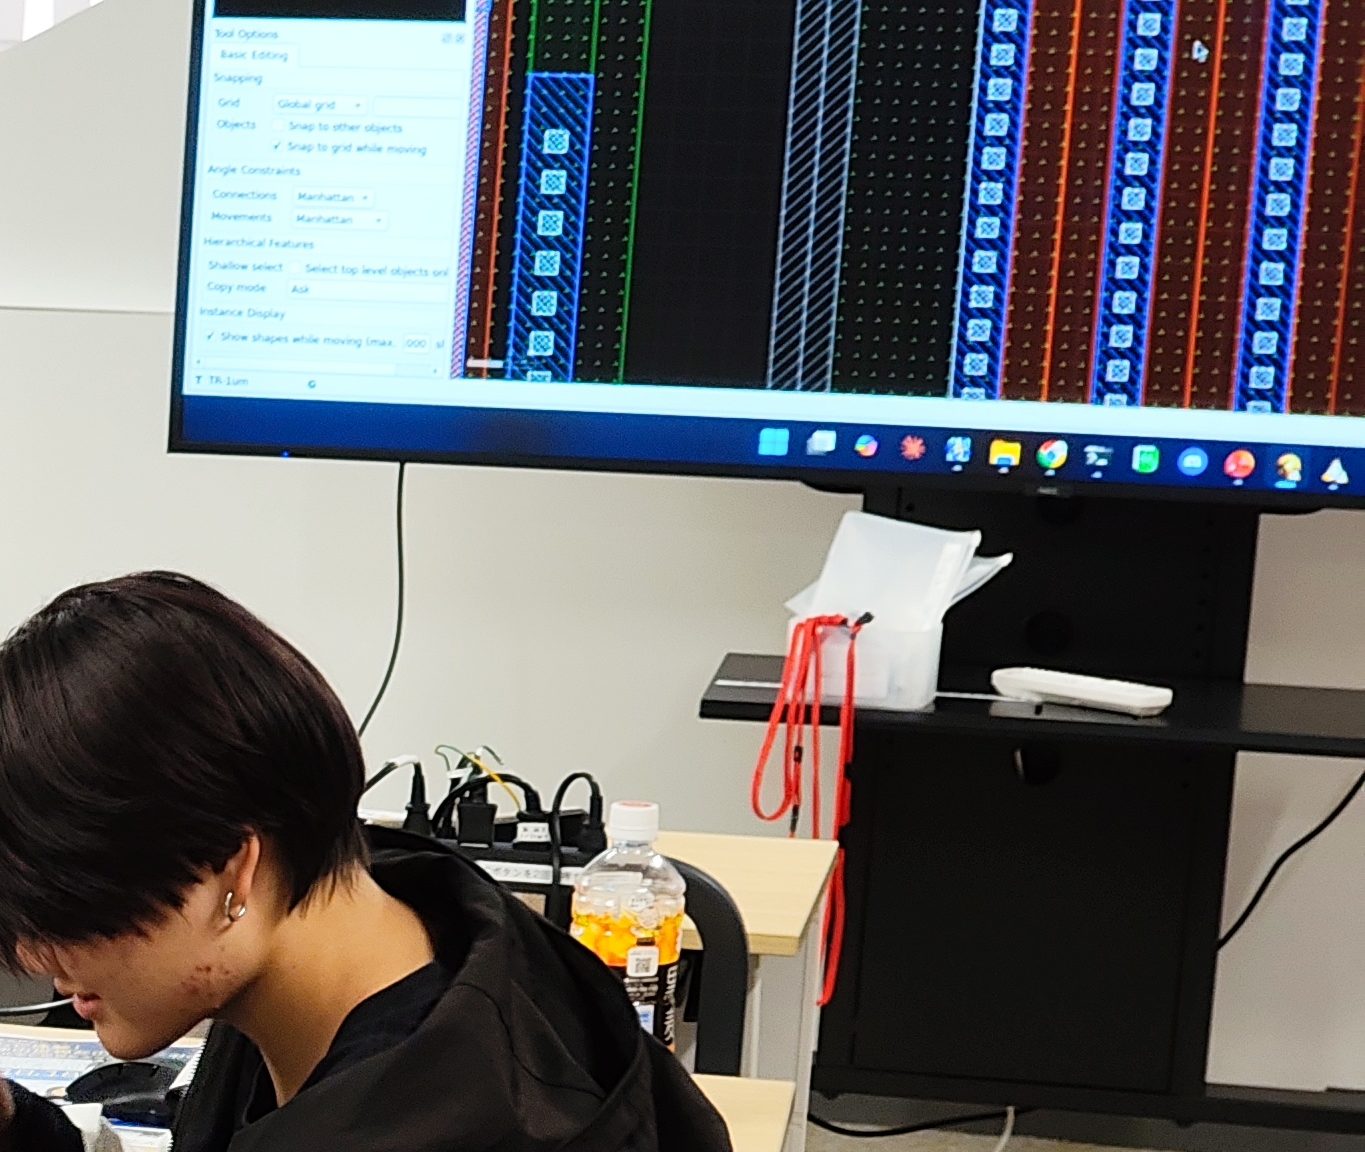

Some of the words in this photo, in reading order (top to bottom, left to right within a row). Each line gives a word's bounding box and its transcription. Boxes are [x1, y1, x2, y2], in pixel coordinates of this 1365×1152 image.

[215, 29, 234, 39] Tool
[239, 30, 278, 40] Options
[221, 50, 246, 60] Basic
[252, 51, 288, 62] Editing
[214, 73, 263, 85] Snapping
[218, 98, 240, 108] Grid
[278, 100, 310, 110] Global
[316, 101, 335, 112] grid
[217, 120, 256, 131] Objects
[290, 122, 314, 133] Snap
[319, 123, 329, 132] to
[333, 123, 360, 133] other
[365, 123, 402, 135] objects
[288, 142, 312, 153] Snap
[317, 143, 328, 152] to
[332, 143, 351, 155] grid
[357, 143, 383, 154] while
[387, 145, 426, 157] moving
[208, 165, 236, 176] Angle
[241, 166, 301, 176] Constraints
[213, 190, 276, 200] Connections
[298, 193, 354, 202] Manhattan
[212, 212, 272, 222] Movements
[297, 215, 352, 224] Manhattan
[204, 237, 266, 248] Hierarchical
[270, 239, 314, 249] Features
[209, 261, 249, 272] Shallow
[253, 262, 282, 272] select
[306, 263, 337, 274] Select
[341, 266, 358, 277] top
[362, 266, 387, 276] level
[391, 266, 428, 278] objects
[207, 282, 232, 294] Copy
[237, 283, 266, 292] mode
[292, 285, 309, 294] Ask
[200, 308, 243, 318] Instance
[247, 309, 285, 320] Display
[221, 333, 248, 342] Show
[253, 333, 288, 345] shapes
[293, 335, 319, 345] while
[323, 337, 362, 349] moving
